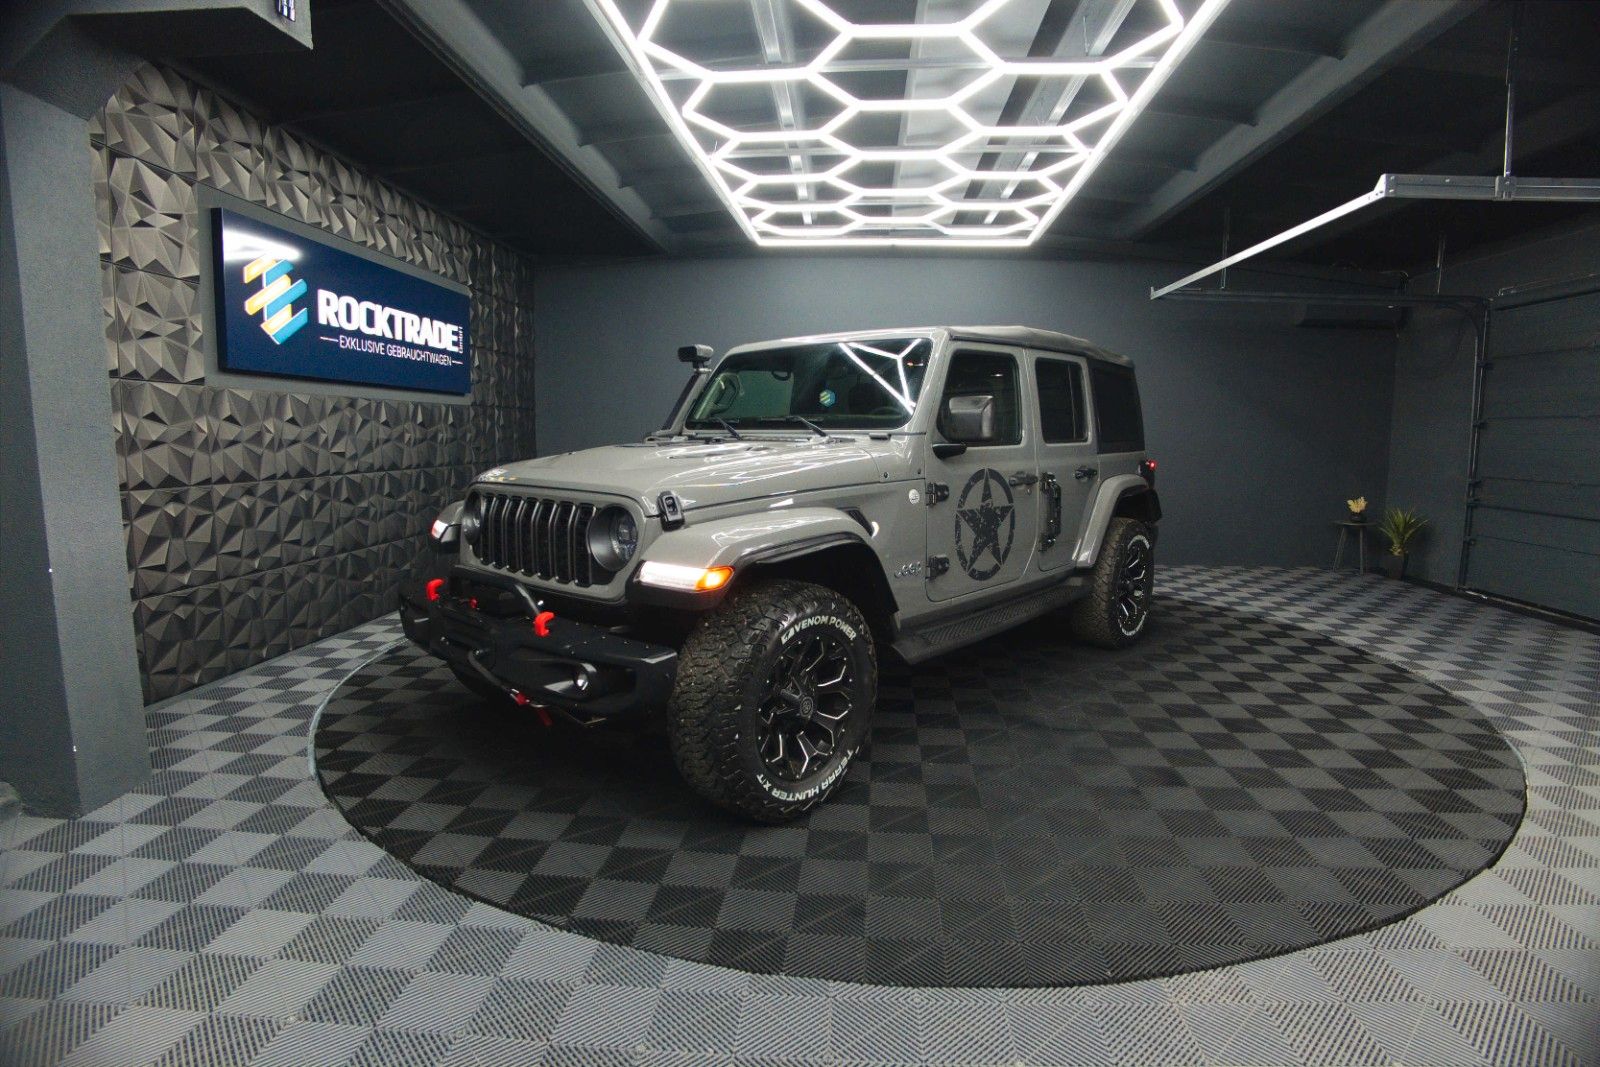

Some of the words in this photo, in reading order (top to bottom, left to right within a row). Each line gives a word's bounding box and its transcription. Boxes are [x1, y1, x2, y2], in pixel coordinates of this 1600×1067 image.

[317, 288, 459, 353] ROCKTRADE
[339, 335, 385, 355] EXKLUSIVE
[386, 344, 452, 366] GEBRAUCHTWAGEN
[794, 615, 829, 633] VENOM
[828, 616, 857, 641] POWER
[821, 749, 854, 790] TERRA
[771, 785, 820, 801] HUNTER
